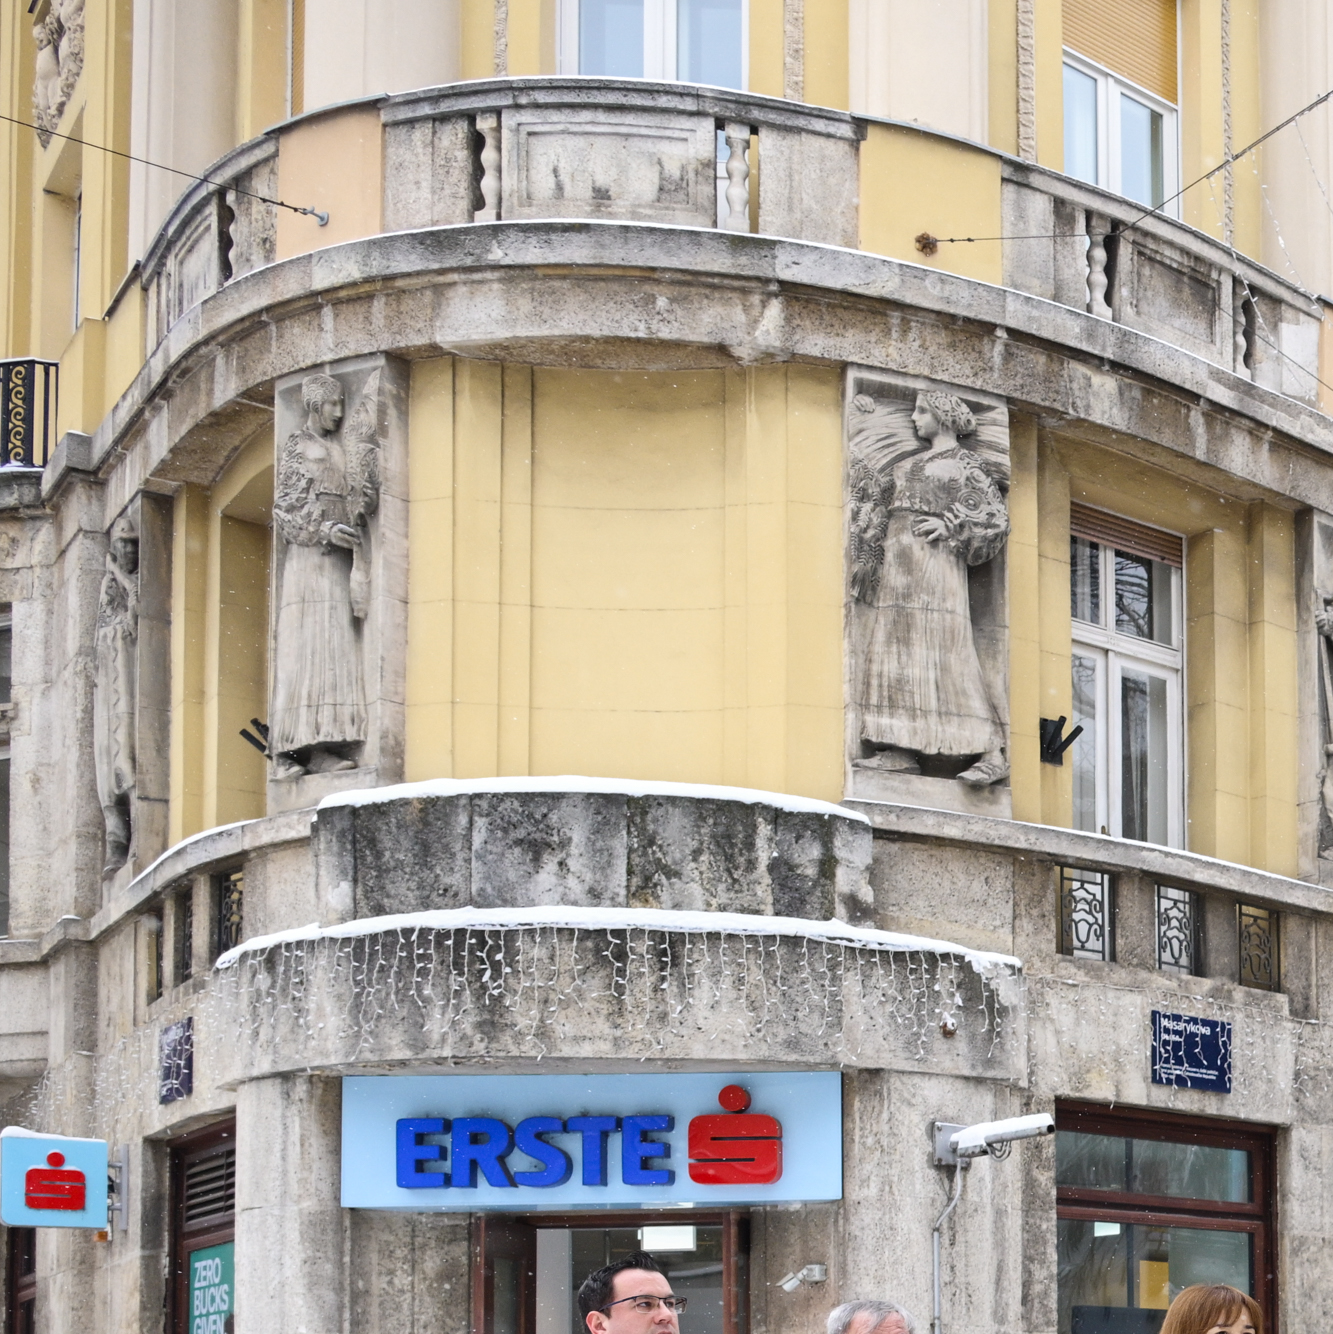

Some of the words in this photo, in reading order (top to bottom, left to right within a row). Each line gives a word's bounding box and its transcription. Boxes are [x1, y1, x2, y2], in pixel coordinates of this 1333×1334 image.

[1160, 1017, 1211, 1036] Masarykova
[396, 1114, 675, 1188] ERSTE
[194, 1257, 221, 1288] ZERO
[194, 1283, 229, 1316] BUCKS
